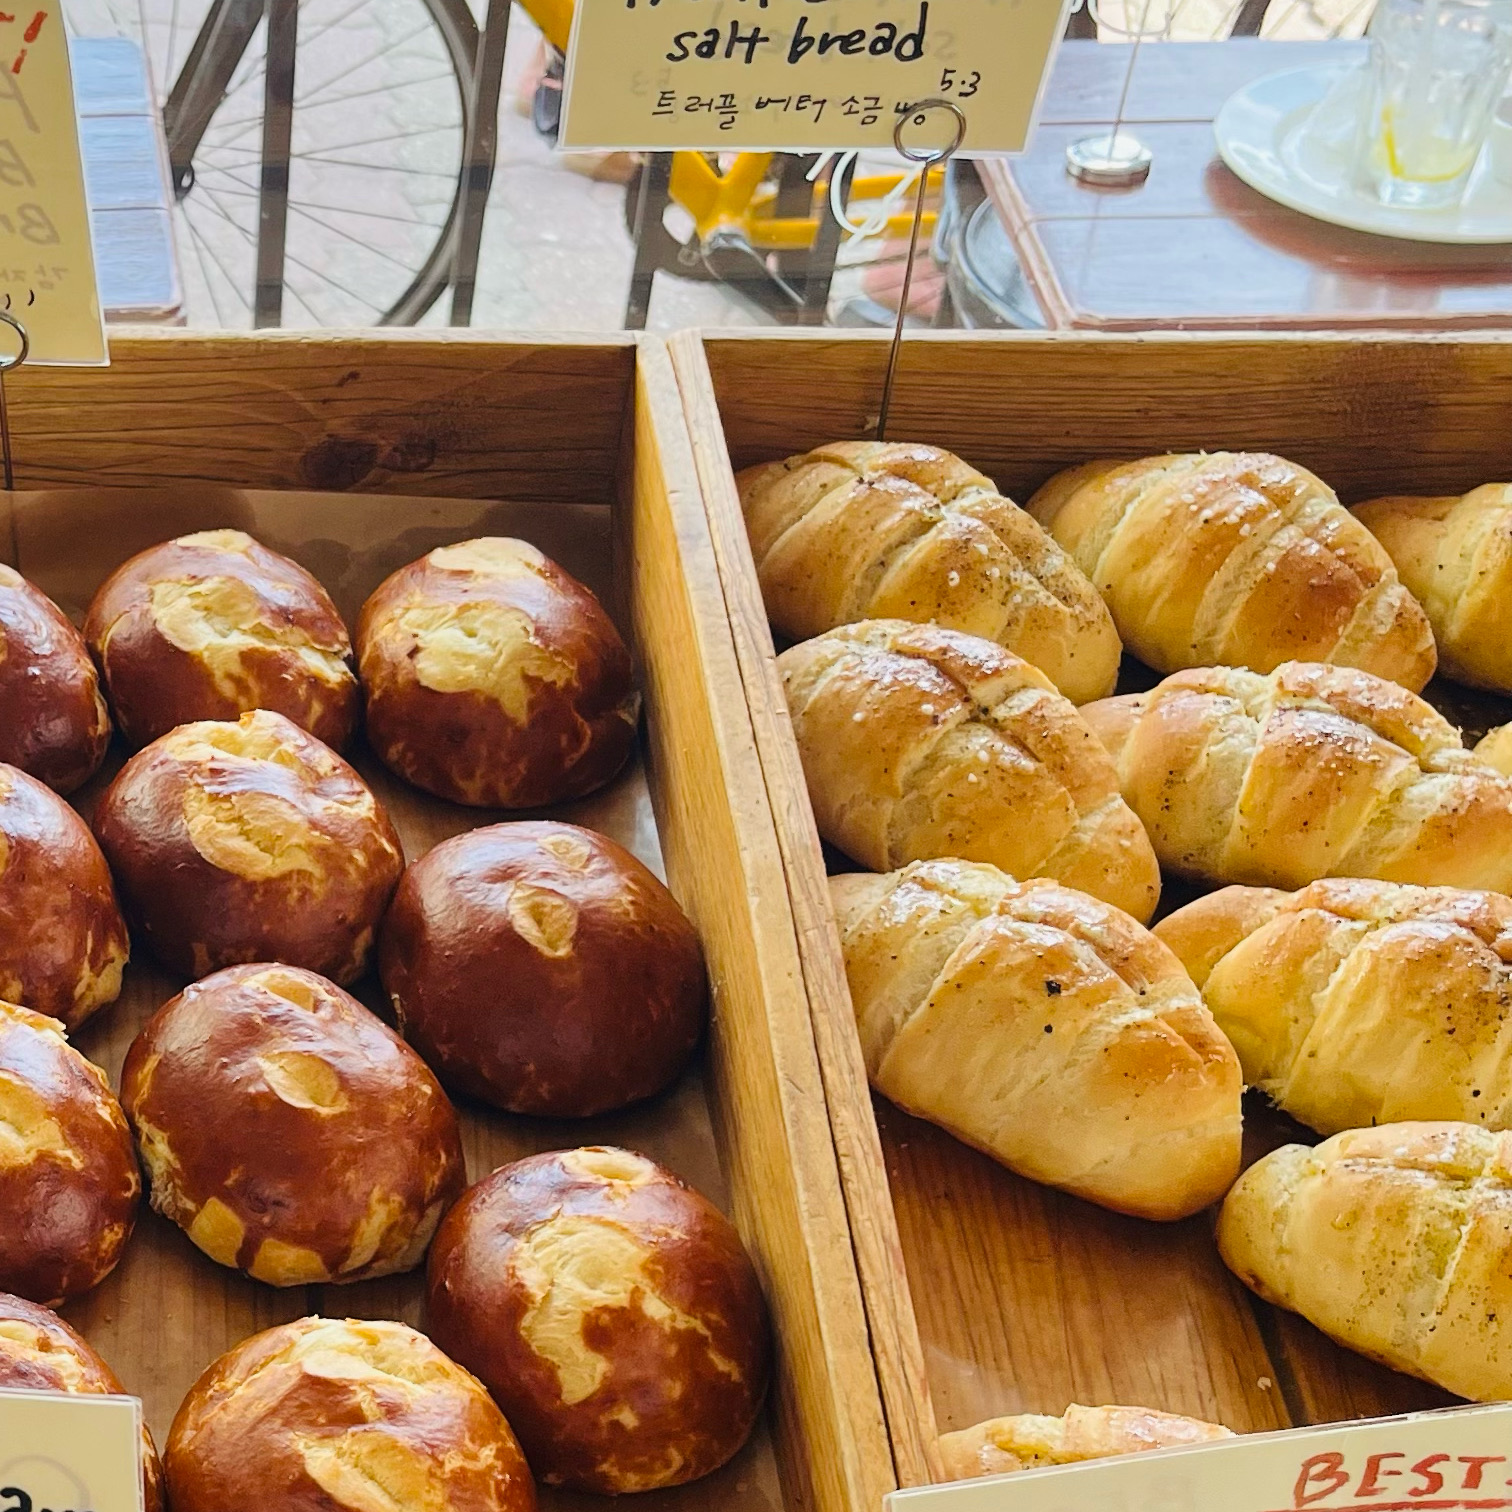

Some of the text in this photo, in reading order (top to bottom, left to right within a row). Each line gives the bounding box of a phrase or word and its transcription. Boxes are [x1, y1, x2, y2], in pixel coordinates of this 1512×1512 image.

[665, 19, 770, 65] salt
[787, 1, 929, 65] bread
[1294, 1452, 1512, 1508] BEST
